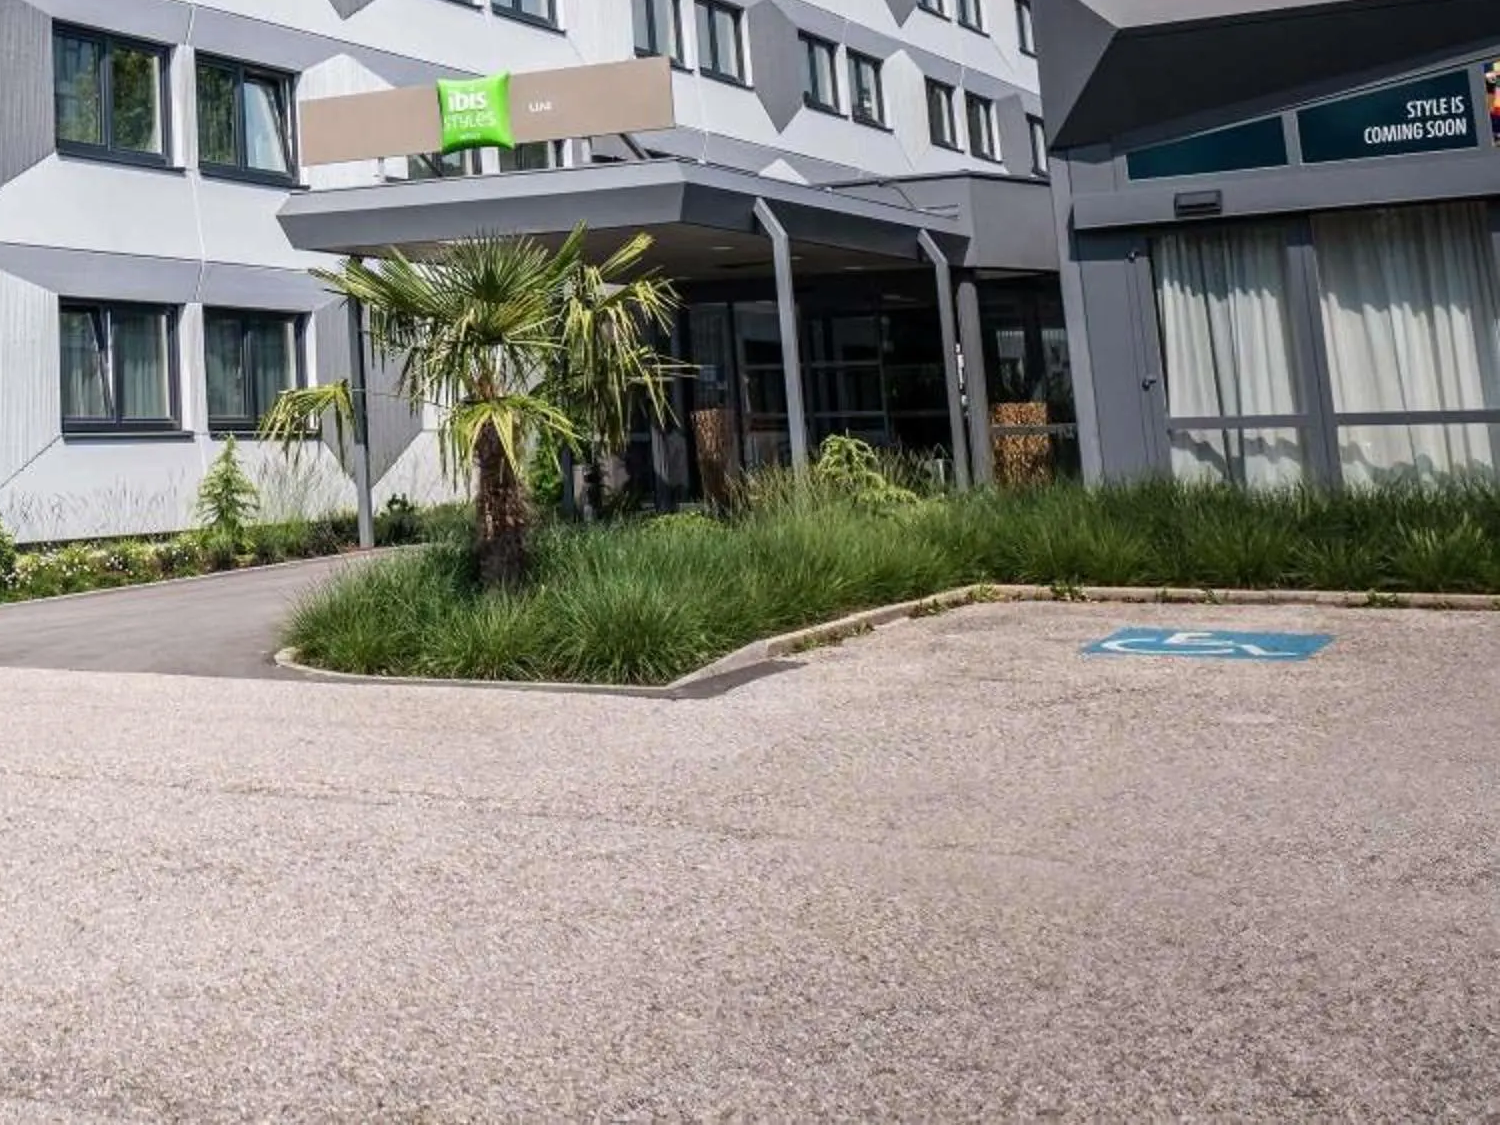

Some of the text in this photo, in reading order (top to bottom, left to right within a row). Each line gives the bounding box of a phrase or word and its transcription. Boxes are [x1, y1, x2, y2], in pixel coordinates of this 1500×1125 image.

[1406, 96, 1465, 118] STYLE IS
[1364, 117, 1468, 144] COMING SOON
